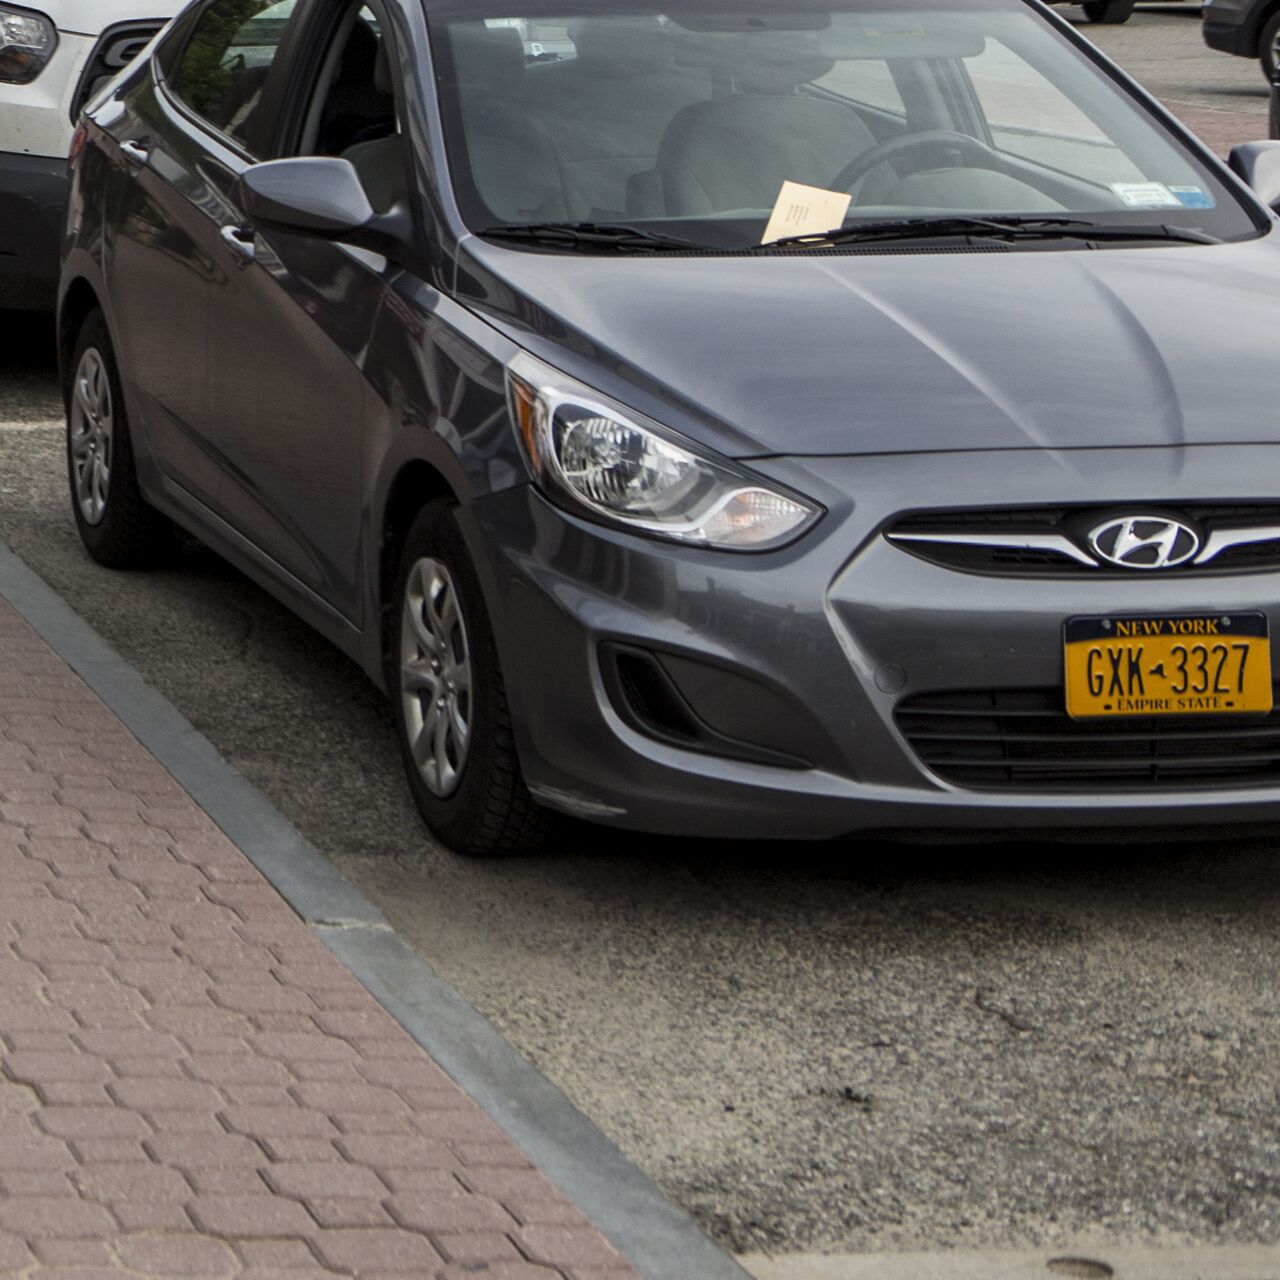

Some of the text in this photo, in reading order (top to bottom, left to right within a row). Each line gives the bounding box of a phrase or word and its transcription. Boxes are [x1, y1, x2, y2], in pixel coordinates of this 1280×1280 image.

[1116, 619, 1219, 636] NEW YORK
[1087, 643, 1250, 697] GXK 3327
[1117, 697, 1222, 711] EMPIRE STATE
